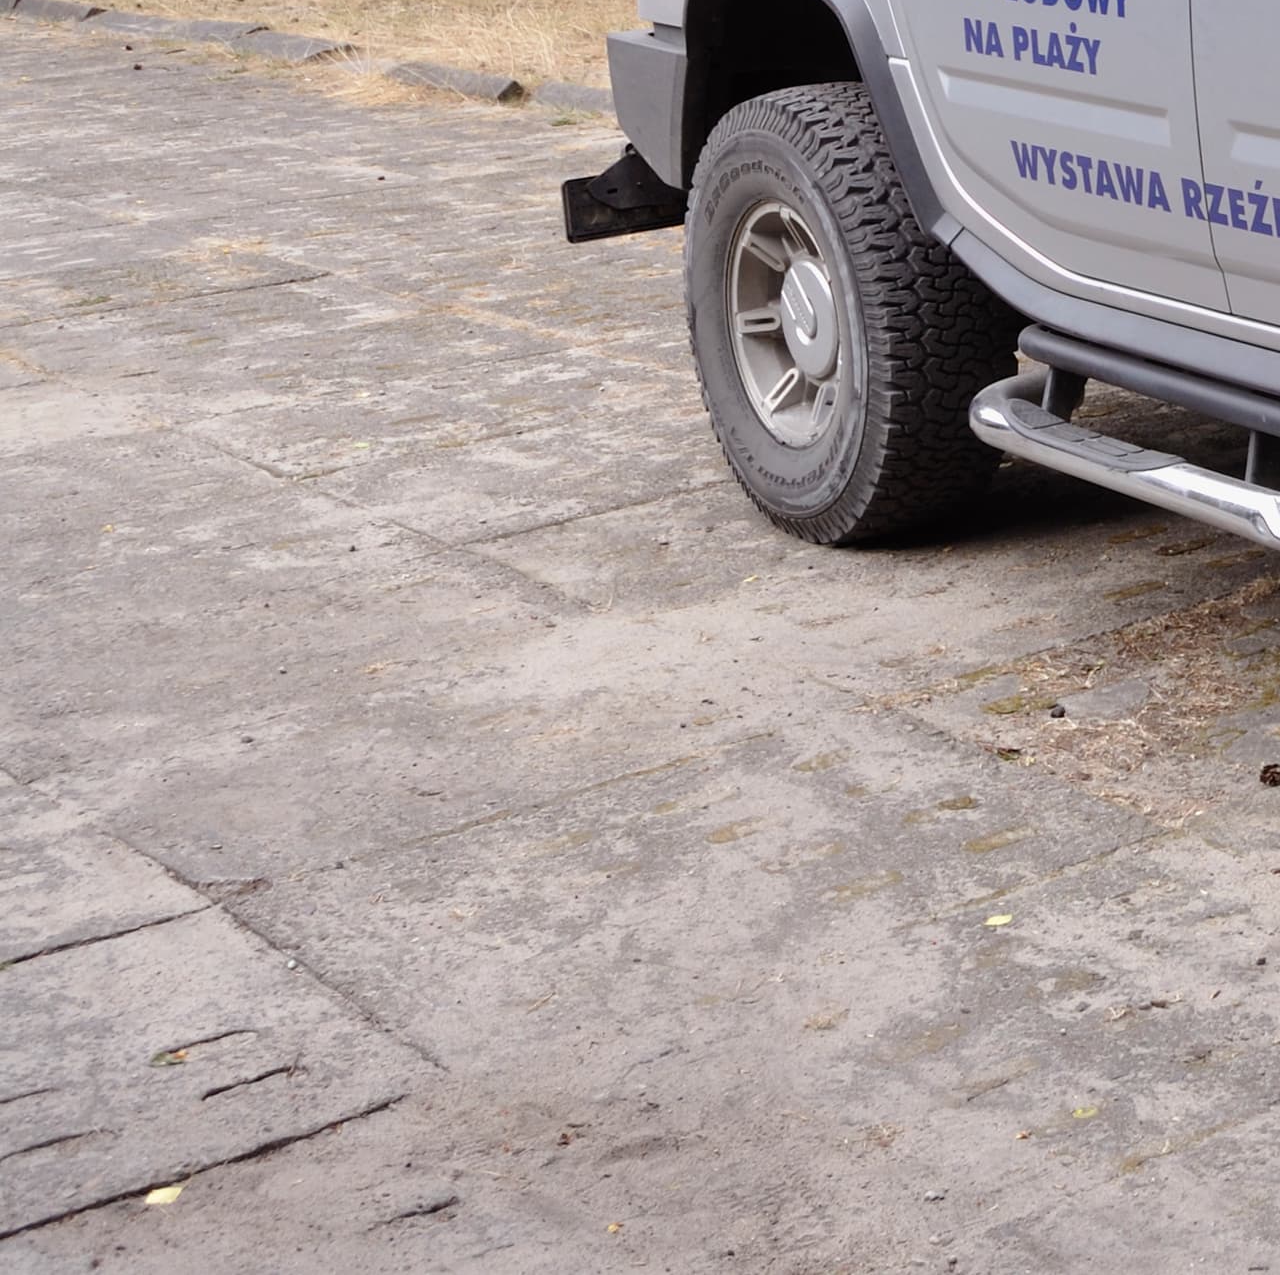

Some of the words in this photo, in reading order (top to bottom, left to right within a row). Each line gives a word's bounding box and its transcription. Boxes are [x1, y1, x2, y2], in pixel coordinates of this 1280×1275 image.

[964, 17, 1004, 58] NA
[1012, 22, 1101, 75] PLAŻY
[1010, 140, 1171, 214] WYSTAWA
